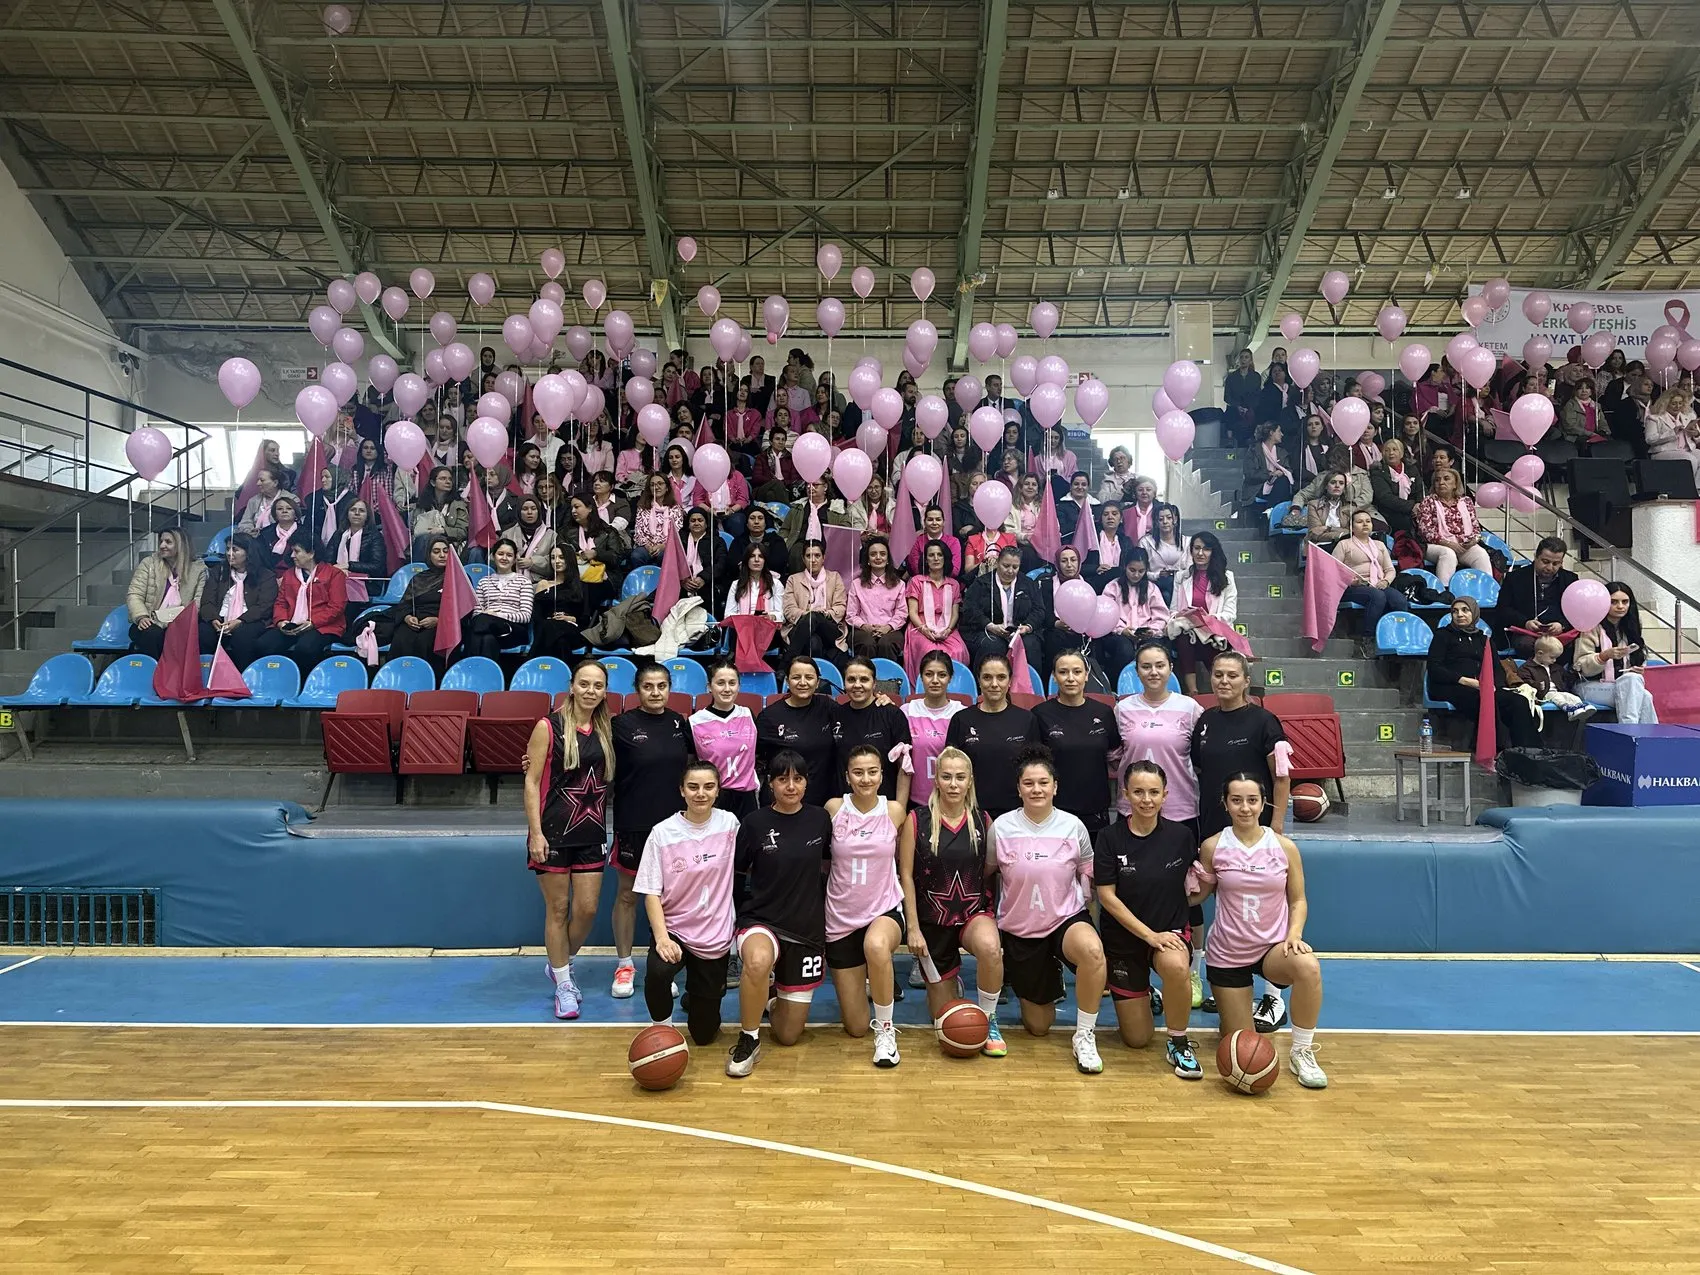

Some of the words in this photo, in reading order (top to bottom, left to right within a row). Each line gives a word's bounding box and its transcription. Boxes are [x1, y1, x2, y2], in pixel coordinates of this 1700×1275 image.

[1553, 303, 1624, 314] KAERDE
[1542, 318, 1573, 329] ERK
[1531, 334, 1576, 345] YAT
[1581, 335, 1649, 346] KARIR
[1215, 521, 1225, 530] G
[1242, 553, 1250, 563] F
[1271, 586, 1280, 597] E
[1268, 672, 1280, 684] C
[1340, 672, 1352, 684] C
[0, 713, 13, 727] B
[1380, 726, 1393, 739] B
[726, 756, 739, 778] K
[1600, 766, 1632, 785] ALKBANK
[1653, 777, 1700, 787] HALKBA
[851, 858, 867, 885] H
[1029, 884, 1045, 912] A
[1242, 894, 1260, 923] R
[802, 955, 822, 978] 22
